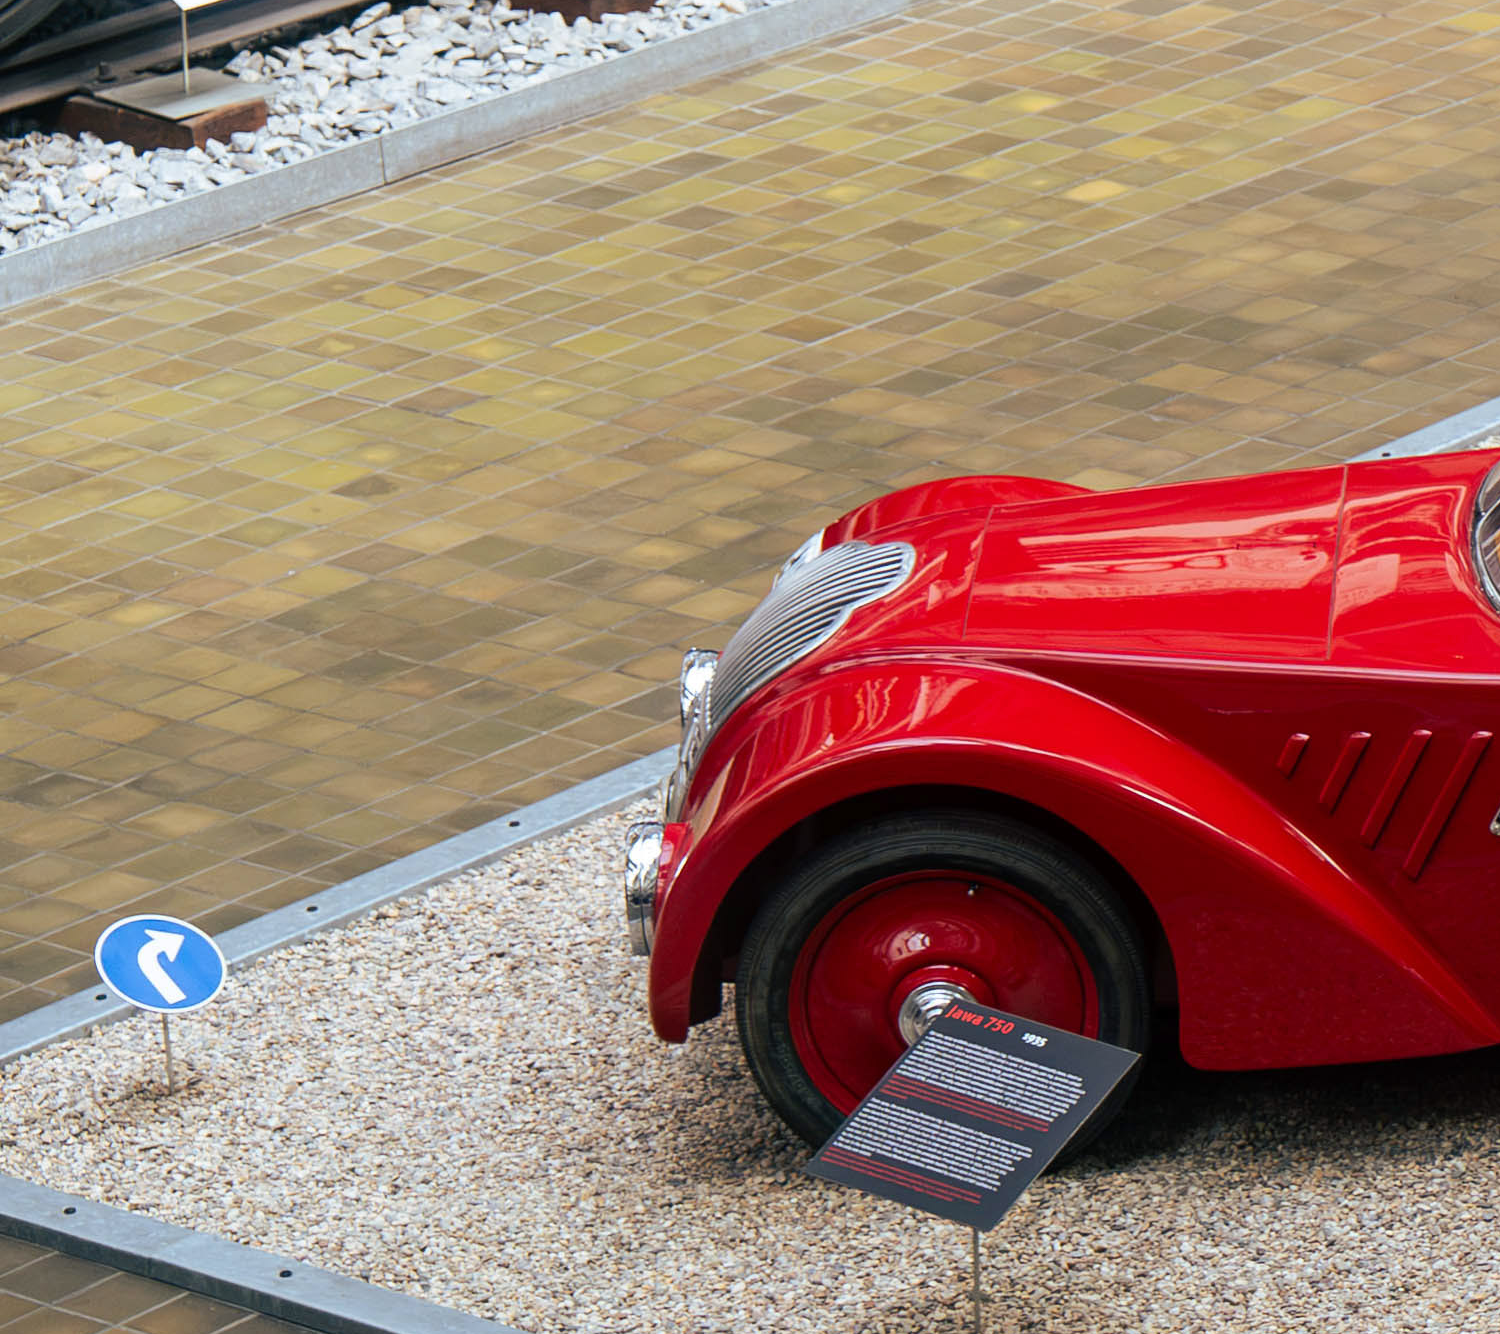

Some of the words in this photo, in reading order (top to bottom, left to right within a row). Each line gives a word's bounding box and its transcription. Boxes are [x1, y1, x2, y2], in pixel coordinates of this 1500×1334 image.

[945, 1004, 983, 1028] Jawa
[983, 1015, 1015, 1035] 750
[1021, 1031, 1049, 1048] 1935
